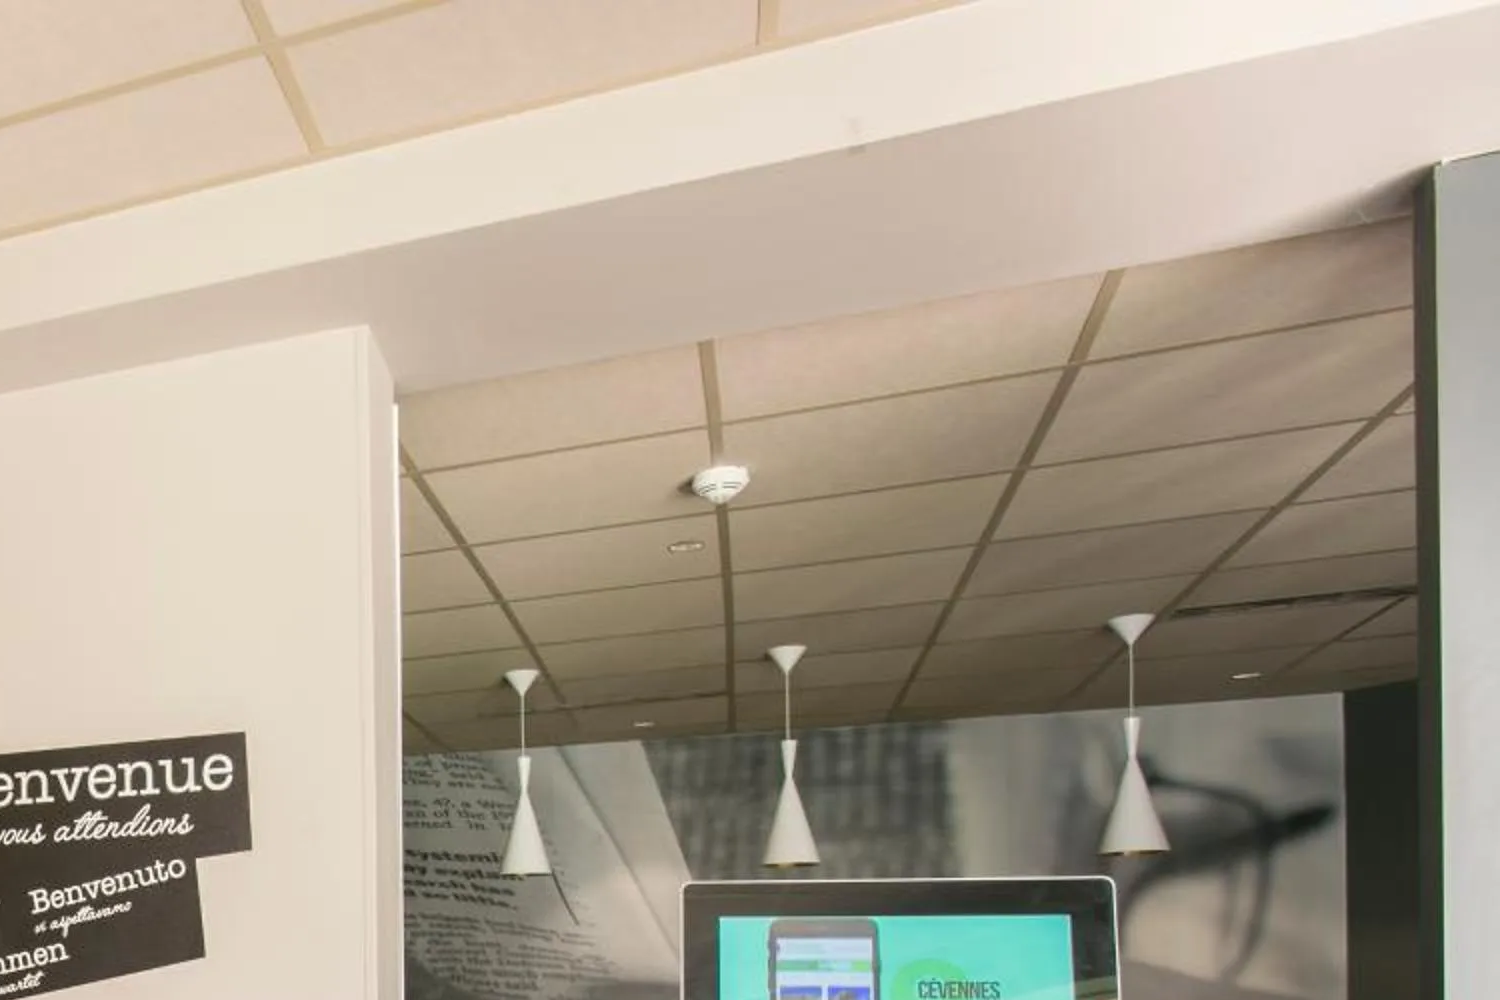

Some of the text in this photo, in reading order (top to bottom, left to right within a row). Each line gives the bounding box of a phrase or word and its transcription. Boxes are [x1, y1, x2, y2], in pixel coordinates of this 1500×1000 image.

[53, 804, 195, 843] attendions
[27, 858, 187, 915] Benvenuto
[918, 977, 1001, 1000] CÉVENNES
